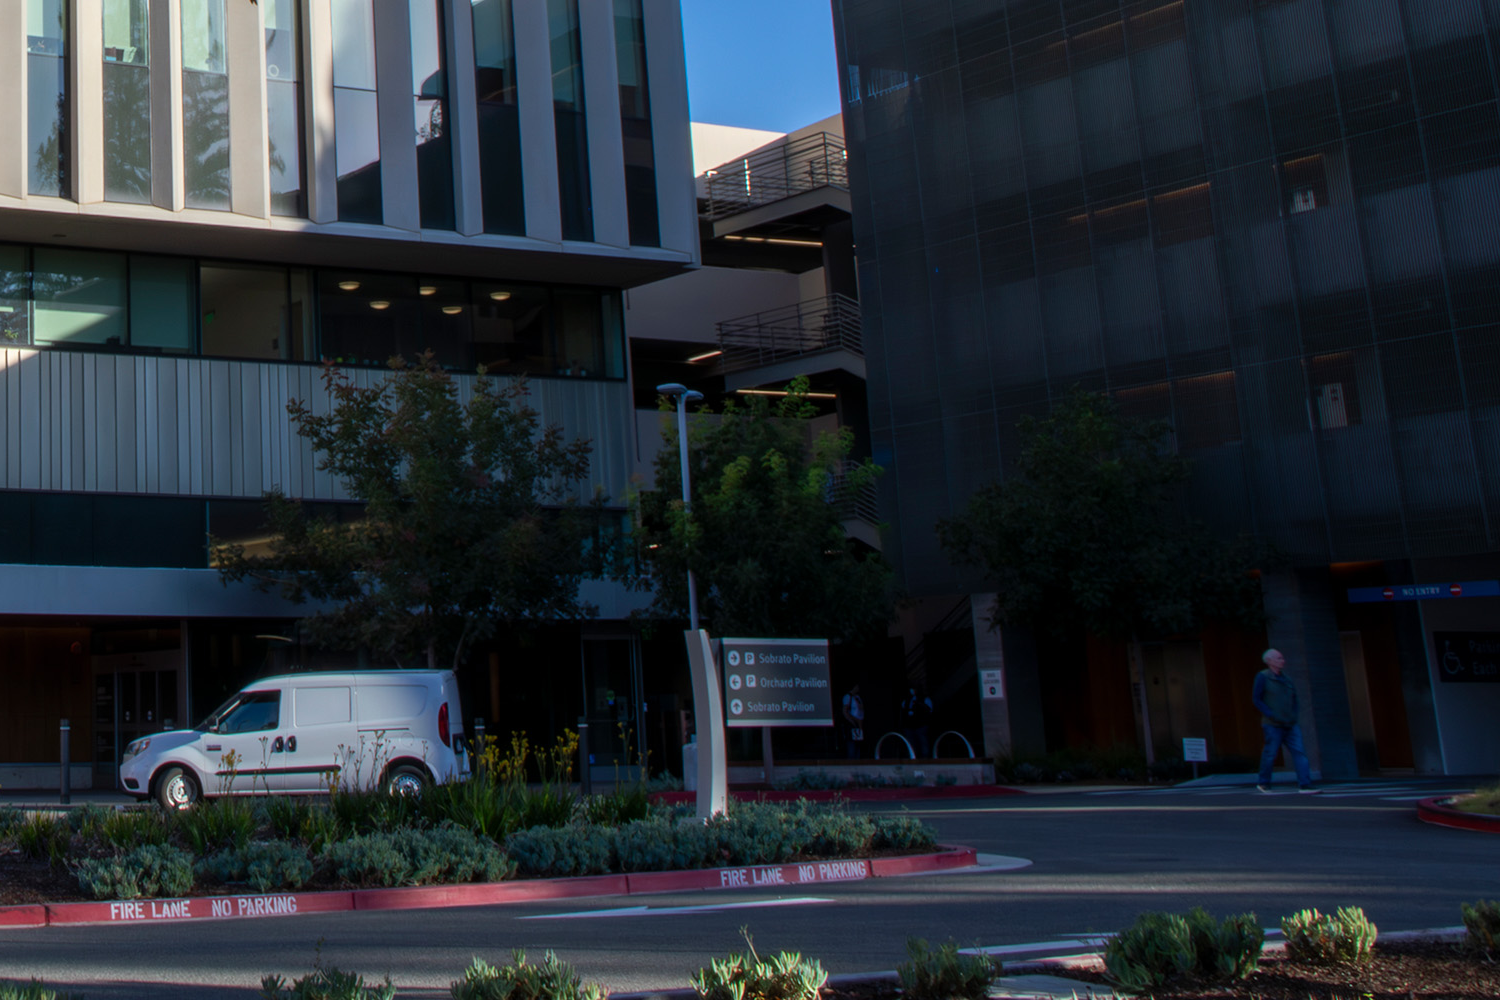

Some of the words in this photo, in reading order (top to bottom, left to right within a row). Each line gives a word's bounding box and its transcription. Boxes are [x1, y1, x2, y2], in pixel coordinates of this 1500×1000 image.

[759, 653, 792, 664] Sobrato
[793, 653, 826, 664] Pavilion
[760, 677, 793, 688] Orchard
[795, 677, 827, 688] Pavilion
[748, 701, 780, 712] Sobrato
[782, 701, 815, 712] Pavilion
[720, 869, 748, 887] FIRE
[752, 867, 784, 885] LANE
[799, 865, 815, 882] NO
[819, 861, 866, 880] PARKING
[111, 902, 145, 919] FIRE
[151, 900, 191, 918] LANE
[212, 899, 232, 917] NO
[238, 896, 297, 916] PARKING
